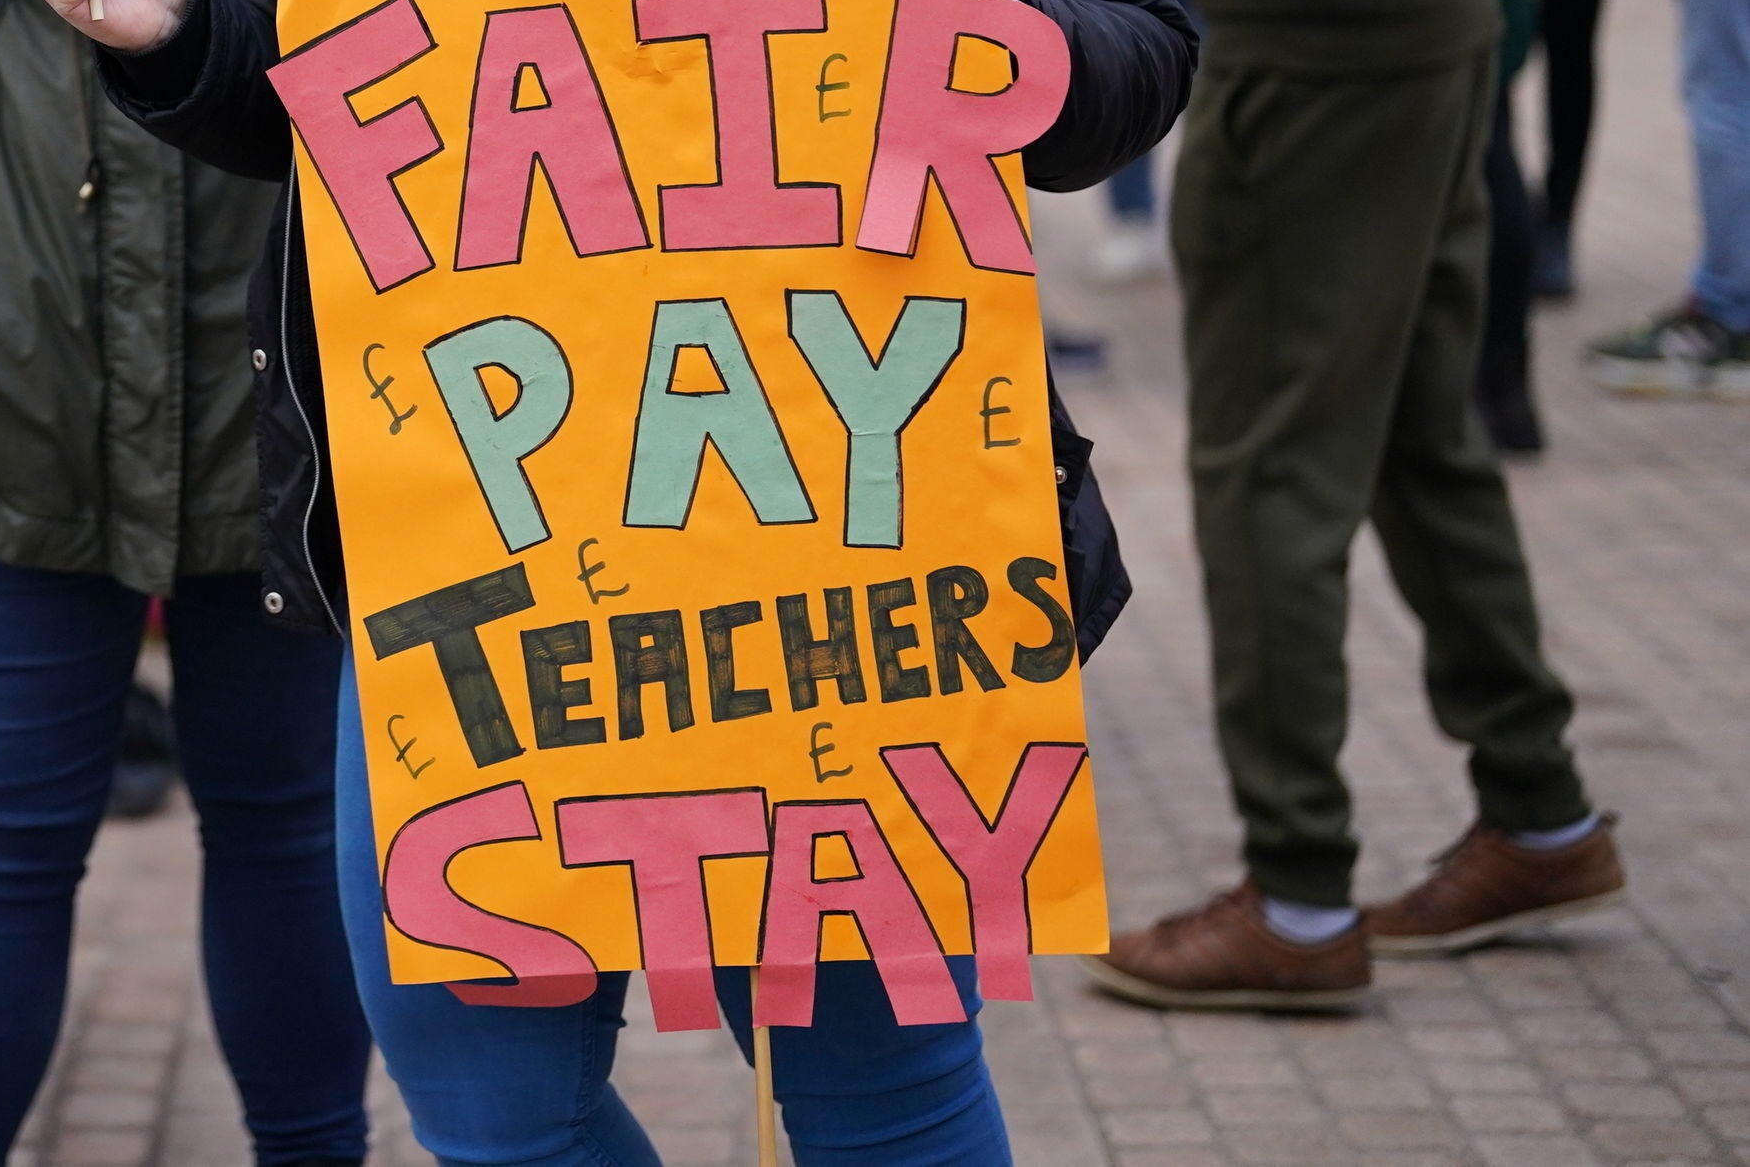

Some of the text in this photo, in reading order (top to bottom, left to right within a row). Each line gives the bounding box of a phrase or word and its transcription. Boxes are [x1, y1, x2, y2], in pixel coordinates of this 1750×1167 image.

[424, 288, 966, 554] PAY
[363, 556, 1076, 769] TEACHERS
[382, 741, 1088, 1031] STAY
